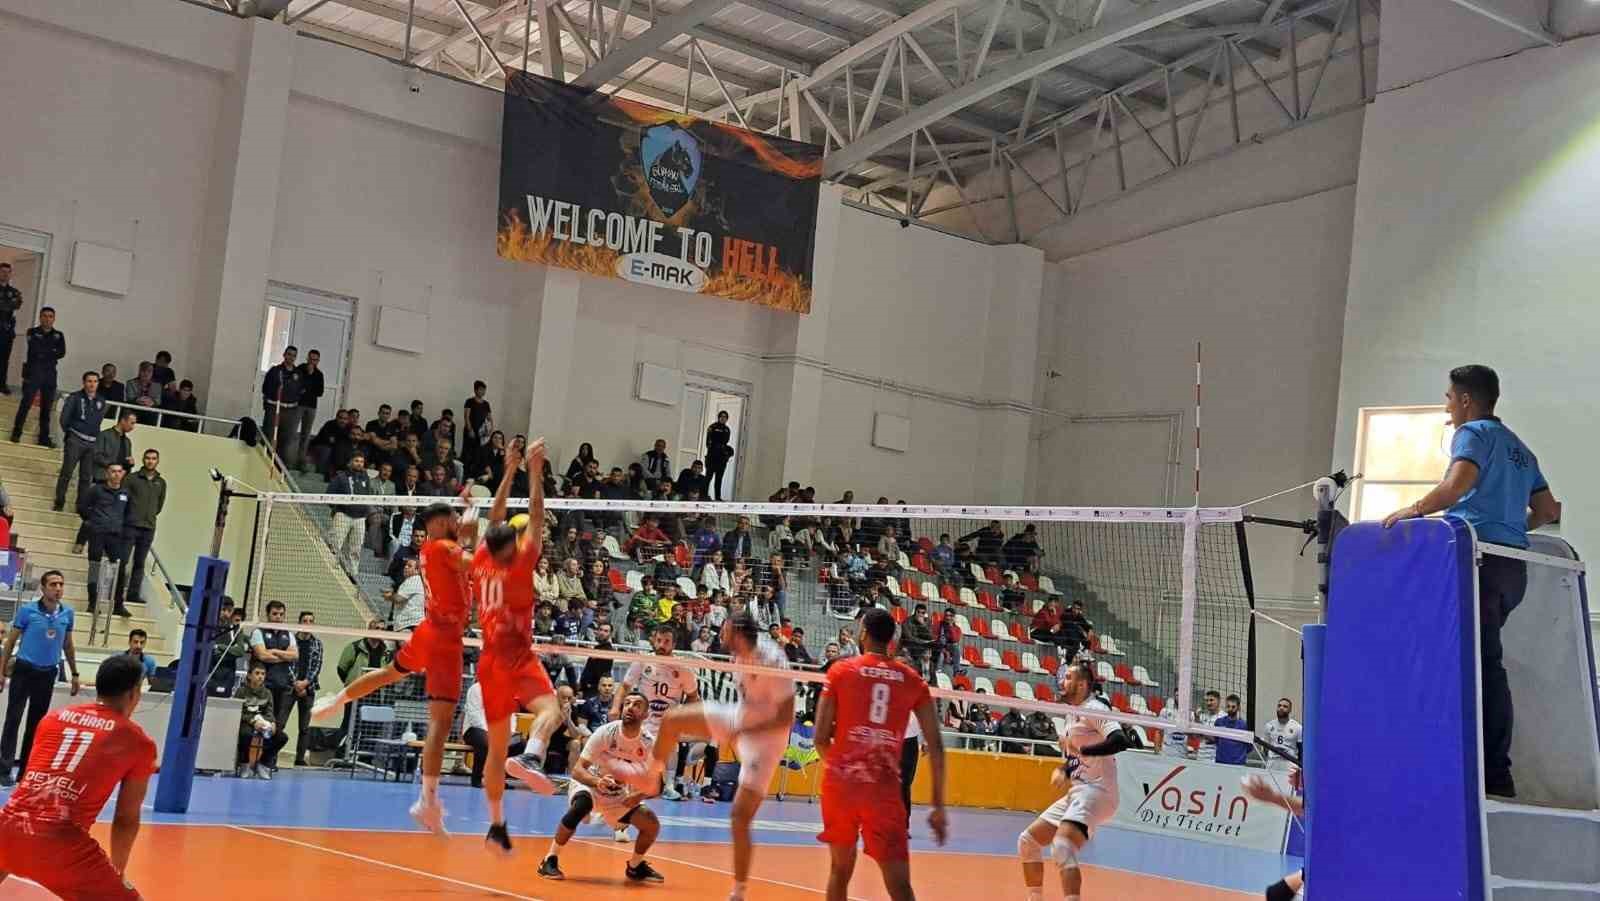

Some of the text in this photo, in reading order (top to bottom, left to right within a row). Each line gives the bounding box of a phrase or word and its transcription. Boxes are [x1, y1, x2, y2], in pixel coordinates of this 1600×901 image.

[526, 194, 785, 281] WELCOME TO HELL
[630, 259, 694, 286] E-MAK
[480, 577, 503, 611] 10
[653, 682, 669, 696] 10
[869, 683, 890, 724] 8
[58, 710, 116, 731] RICHARD
[51, 727, 95, 773] 11
[1277, 735, 1284, 745] 6
[1136, 765, 1249, 822] Yasin
[1176, 814, 1241, 837] Ticaret
